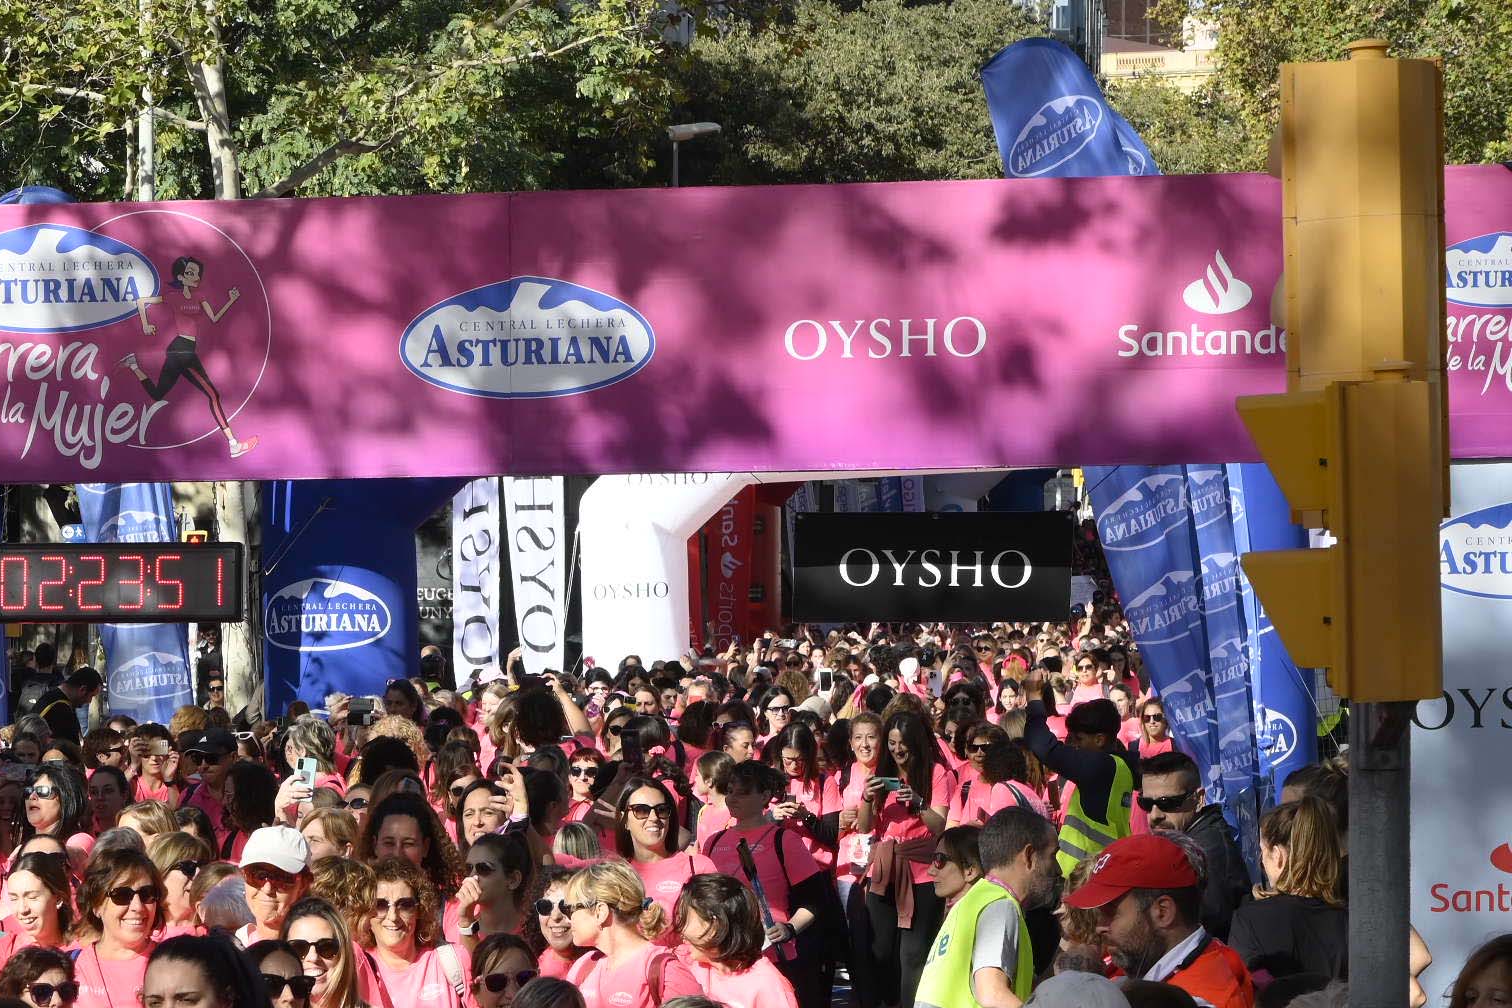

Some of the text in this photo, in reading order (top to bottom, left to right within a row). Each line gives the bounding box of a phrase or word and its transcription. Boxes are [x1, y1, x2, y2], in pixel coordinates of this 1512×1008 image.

[62, 260, 135, 272] LECHERA
[458, 317, 626, 333] CENTRAL LECHERA
[784, 316, 988, 361] OYSHO
[419, 323, 636, 368] ASTURIANA
[1467, 343, 1486, 371] la
[1, 383, 25, 423] la
[20, 381, 169, 470] Mujer
[839, 548, 1032, 588] OYSHO
[0, 556, 223, 609] 02:23:51
[593, 581, 669, 600] OYSHO
[328, 602, 376, 611] LECHERA
[269, 613, 381, 635] ASTURIANA
